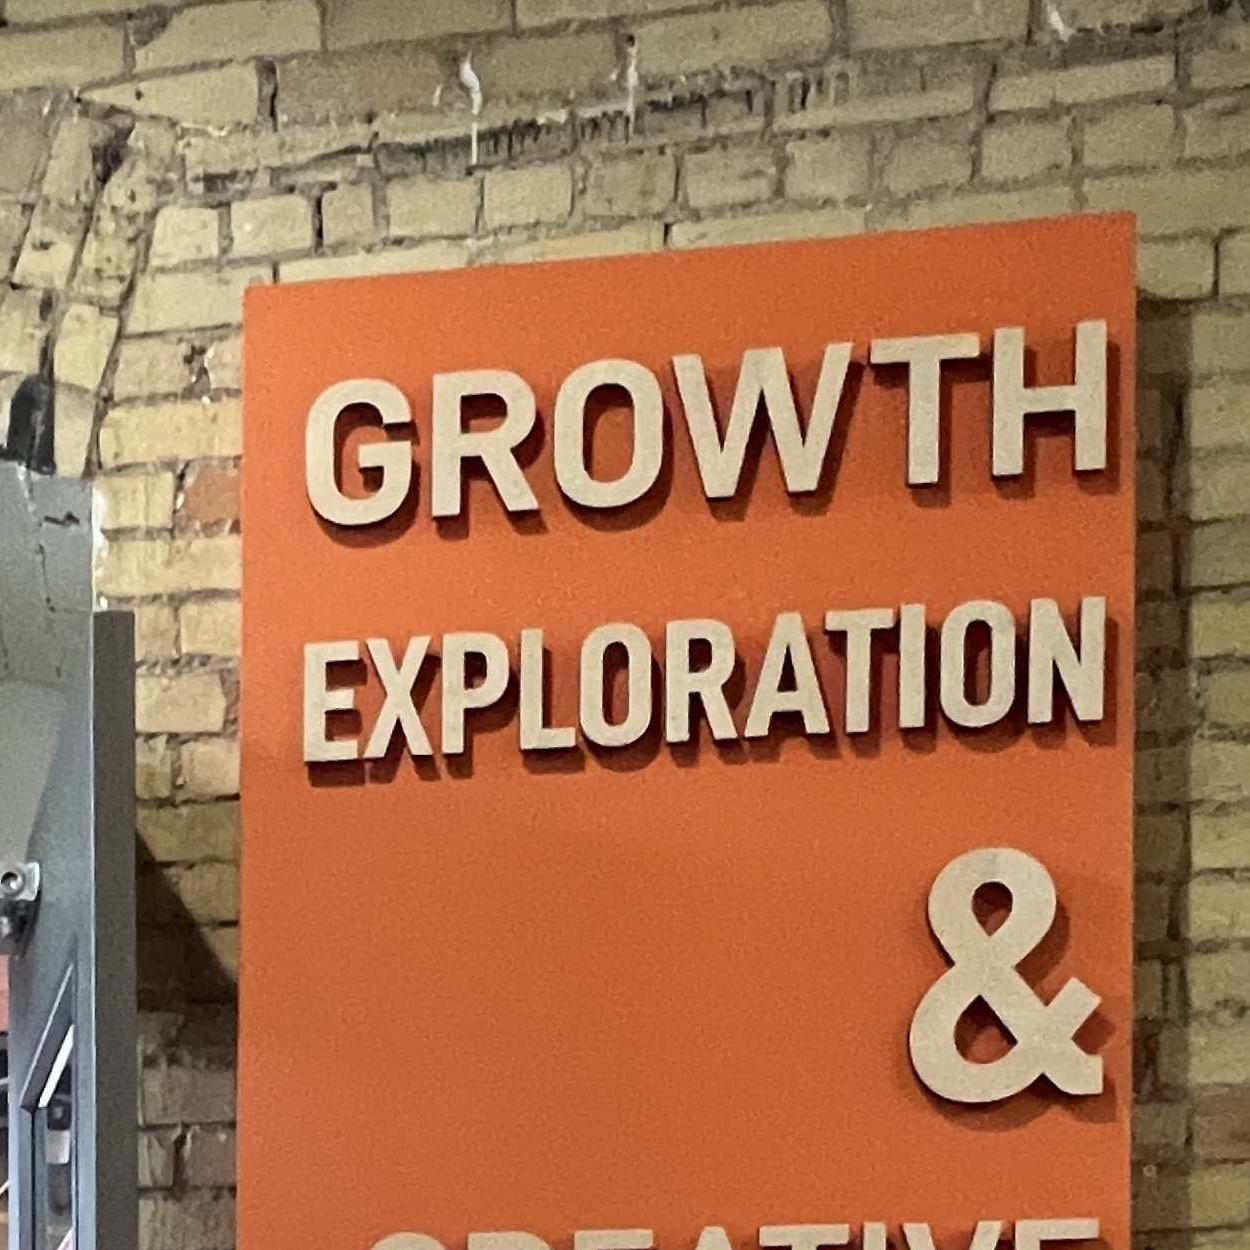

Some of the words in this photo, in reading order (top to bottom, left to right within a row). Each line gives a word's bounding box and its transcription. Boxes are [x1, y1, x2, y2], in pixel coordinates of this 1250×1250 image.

[304, 320, 1108, 526] GROWTH
[302, 596, 1106, 763] EXPLORATION
[908, 847, 1104, 1104] &
